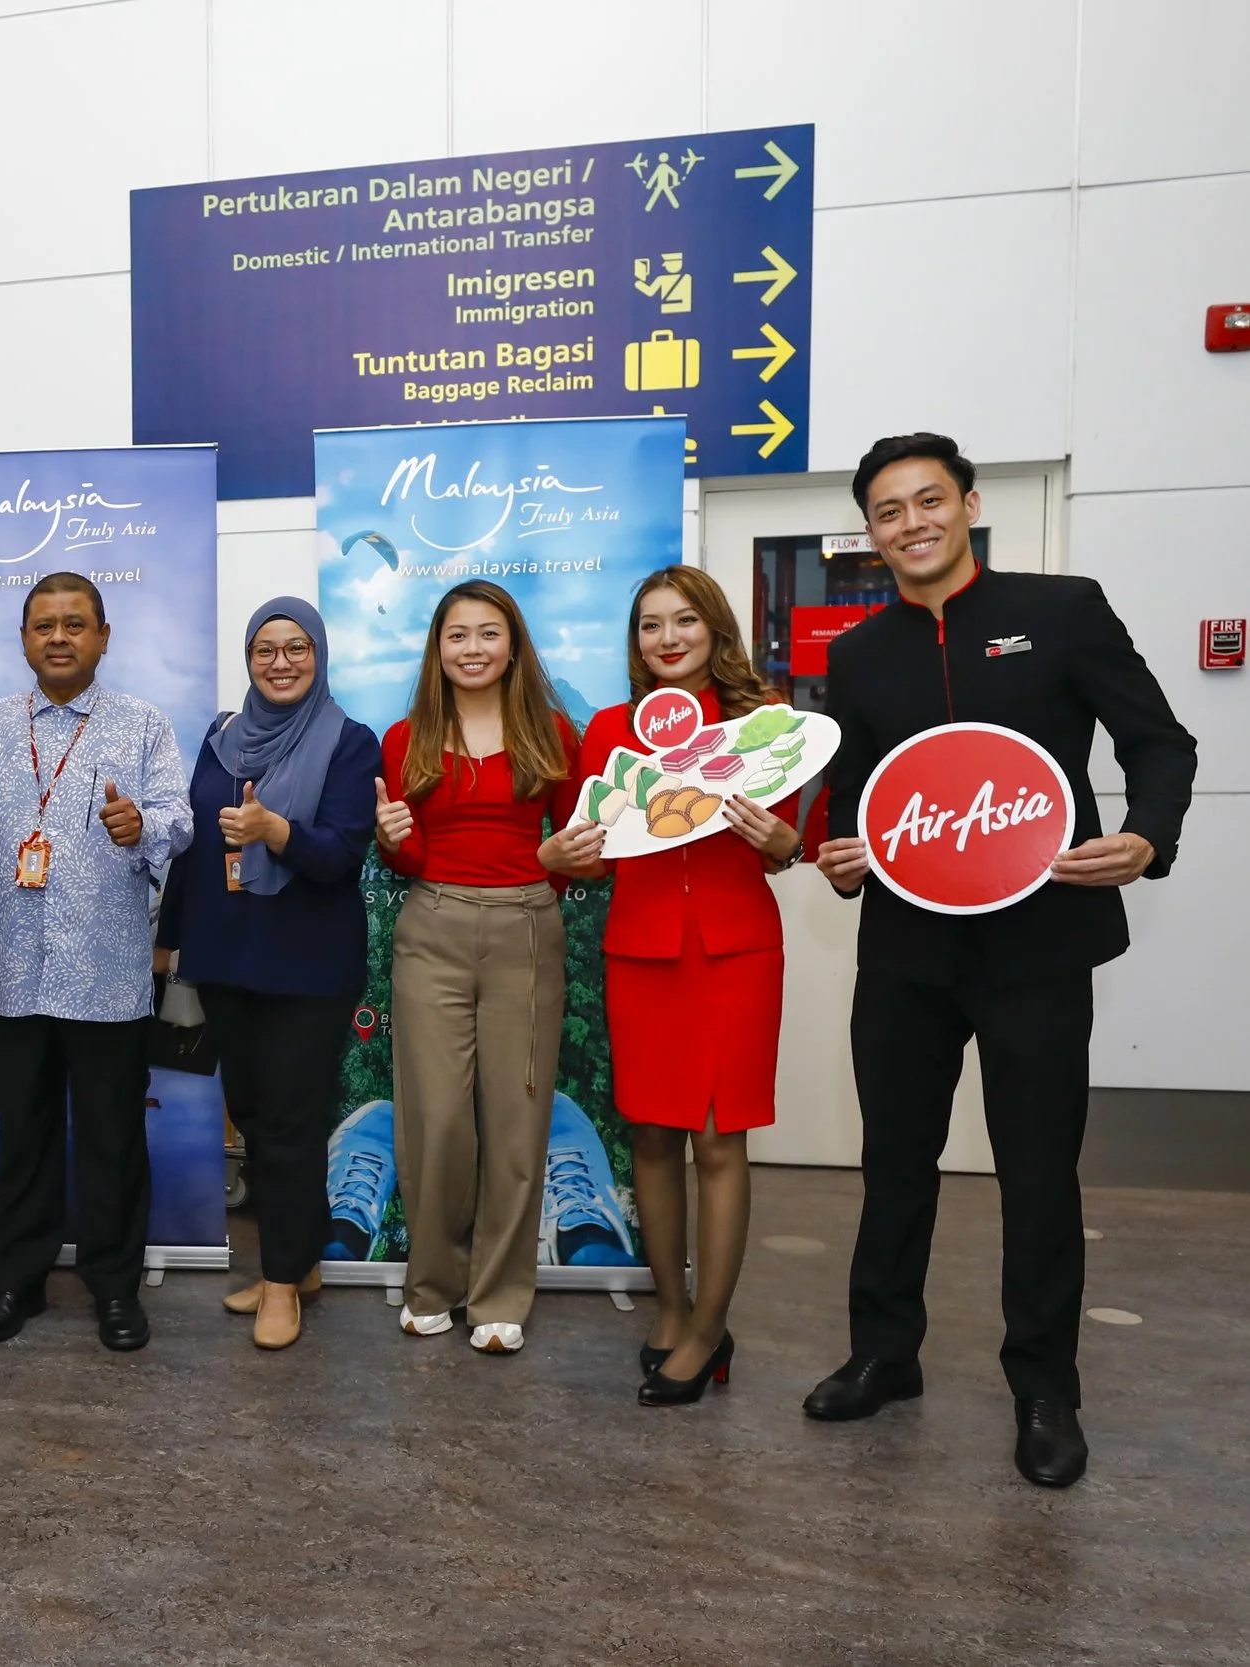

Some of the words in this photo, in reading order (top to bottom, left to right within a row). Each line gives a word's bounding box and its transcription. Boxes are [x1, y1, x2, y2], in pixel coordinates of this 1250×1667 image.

[203, 186, 359, 218] Pertukaran
[368, 172, 462, 203] Dalam
[471, 158, 572, 196] Negeri
[581, 157, 596, 184] /
[383, 197, 595, 234] Antarabangsa
[232, 245, 331, 272] Domestic
[335, 244, 346, 263] /
[351, 229, 495, 262] International
[500, 224, 595, 249] Transfer
[447, 268, 595, 300] Imigresen
[455, 298, 594, 325] Immigration
[352, 348, 486, 377] Tuntutan
[496, 335, 594, 372] Bagasi
[403, 381, 501, 404] Baggage
[506, 370, 594, 395] Reclaim
[381, 453, 603, 551] Malaysia
[518, 502, 574, 527] Truly
[580, 505, 620, 522] Asia
[65, 518, 115, 540] Truly
[121, 521, 157, 536] Asia
[830, 538, 859, 549] FLOW
[400, 556, 602, 577] www.malaysia.travel
[1211, 620, 1242, 631] FIRE
